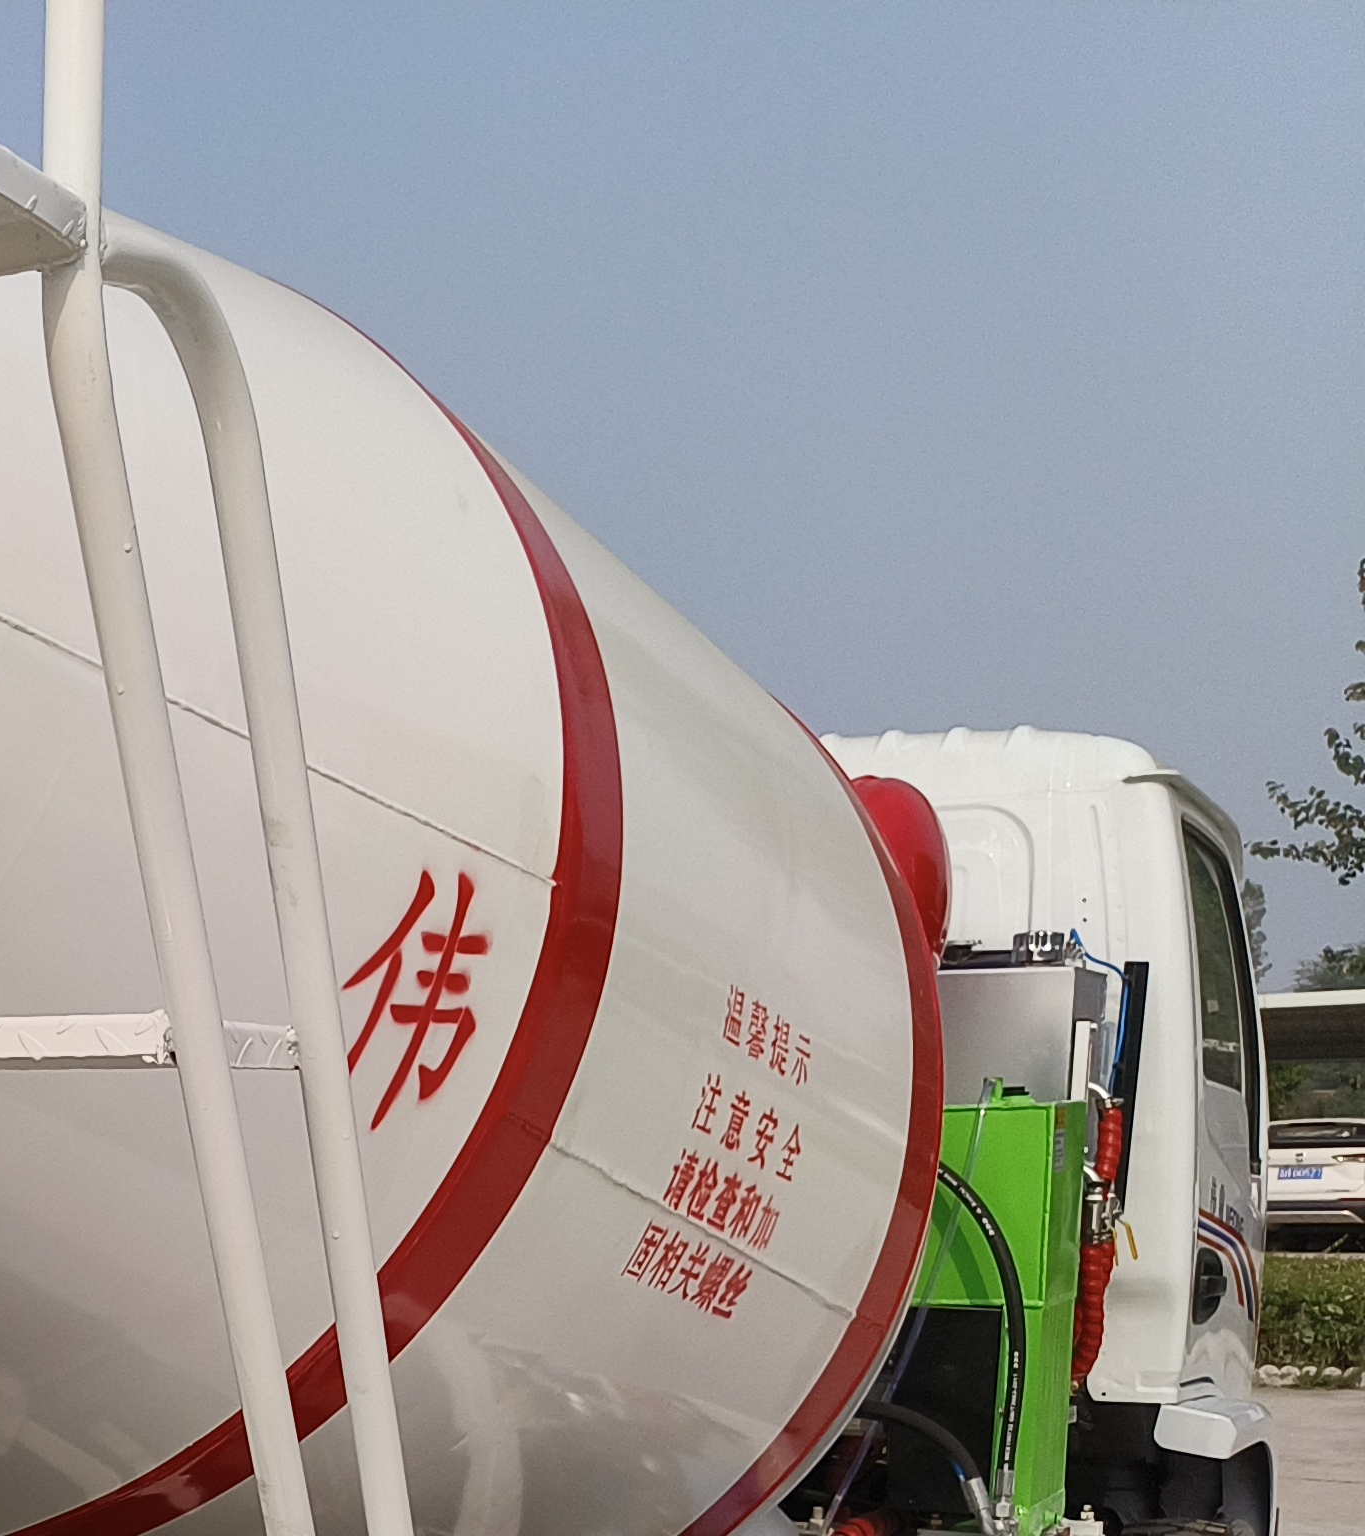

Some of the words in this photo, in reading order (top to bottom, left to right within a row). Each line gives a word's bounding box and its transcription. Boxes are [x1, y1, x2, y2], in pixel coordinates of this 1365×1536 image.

[341, 869, 492, 1131] 伟
[722, 984, 811, 1086] 温馨提示
[690, 1072, 802, 1182] 注意安全
[662, 1147, 780, 1251] 请检查和加
[620, 1219, 753, 1320] 固相关螺丝
